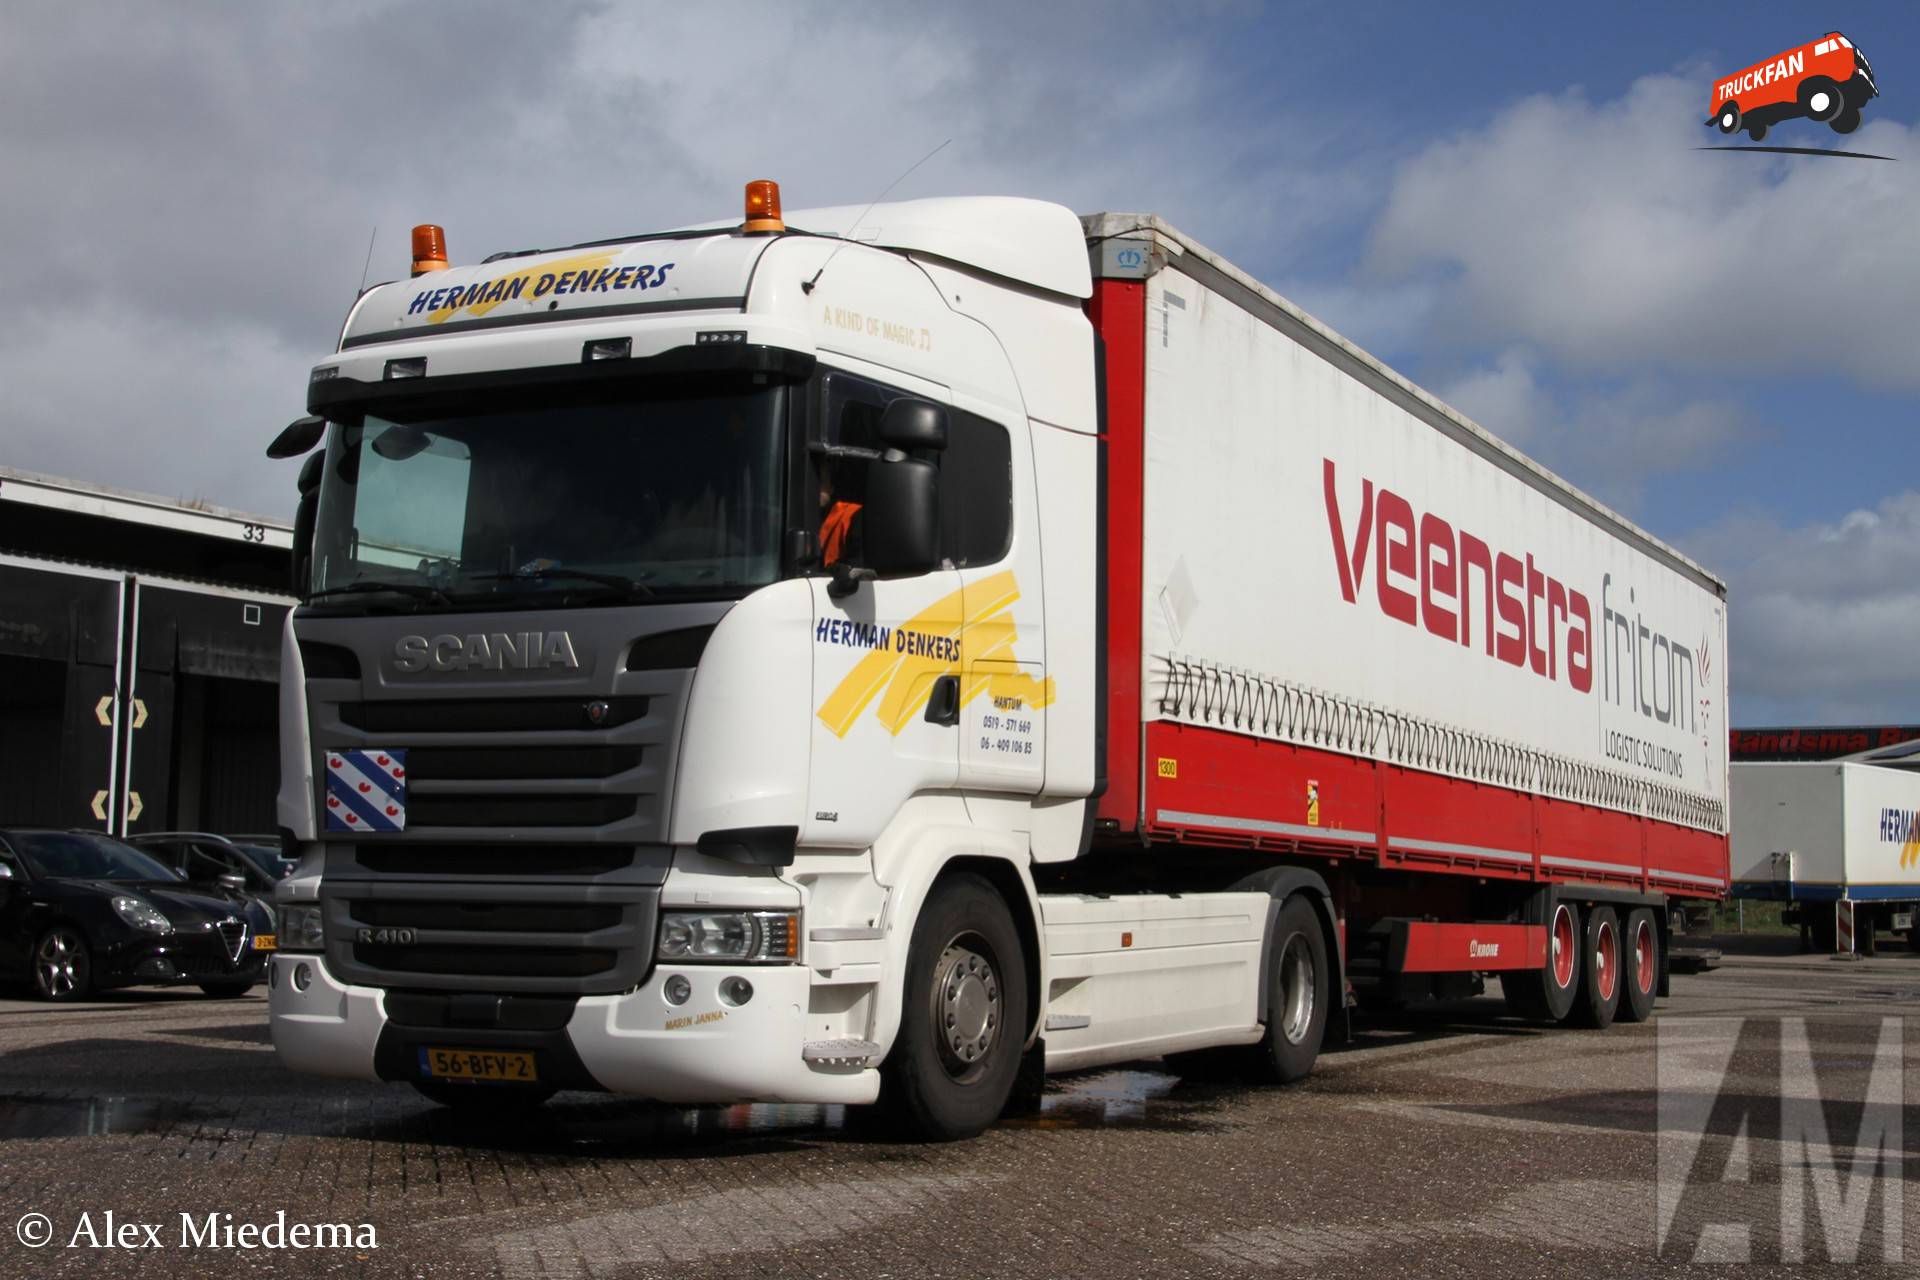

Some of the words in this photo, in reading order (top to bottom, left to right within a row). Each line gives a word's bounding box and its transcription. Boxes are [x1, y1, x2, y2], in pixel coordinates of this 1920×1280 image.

[407, 275, 531, 315] HERMAN
[533, 263, 675, 298] DENKERS
[824, 305, 832, 325] A
[835, 308, 863, 332] KIND
[866, 316, 879, 336] OF
[882, 321, 915, 348] MAGIC
[243, 523, 264, 542] 33
[816, 617, 890, 651] HERMAN
[896, 629, 961, 662] DENKERS
[393, 631, 579, 673] SCANIA
[1602, 573, 1695, 735] fritom
[994, 695, 1022, 711] HANTUM
[983, 715, 1000, 730] 0519
[1006, 718, 1017, 732] 571
[1018, 720, 1031, 734] 669
[981, 736, 990, 750] 06
[1011, 740, 1023, 754] 106
[1605, 728, 1641, 766] LOGISTIC
[1643, 740, 1683, 779] SOLUTIONS
[358, 929, 371, 943] R
[375, 929, 412, 944] 410
[1477, 943, 1499, 957] KRONE
[665, 1016, 692, 1030] MARIN
[695, 1010, 723, 1024] JANNA
[435, 1053, 529, 1076] 56-BFV-2
